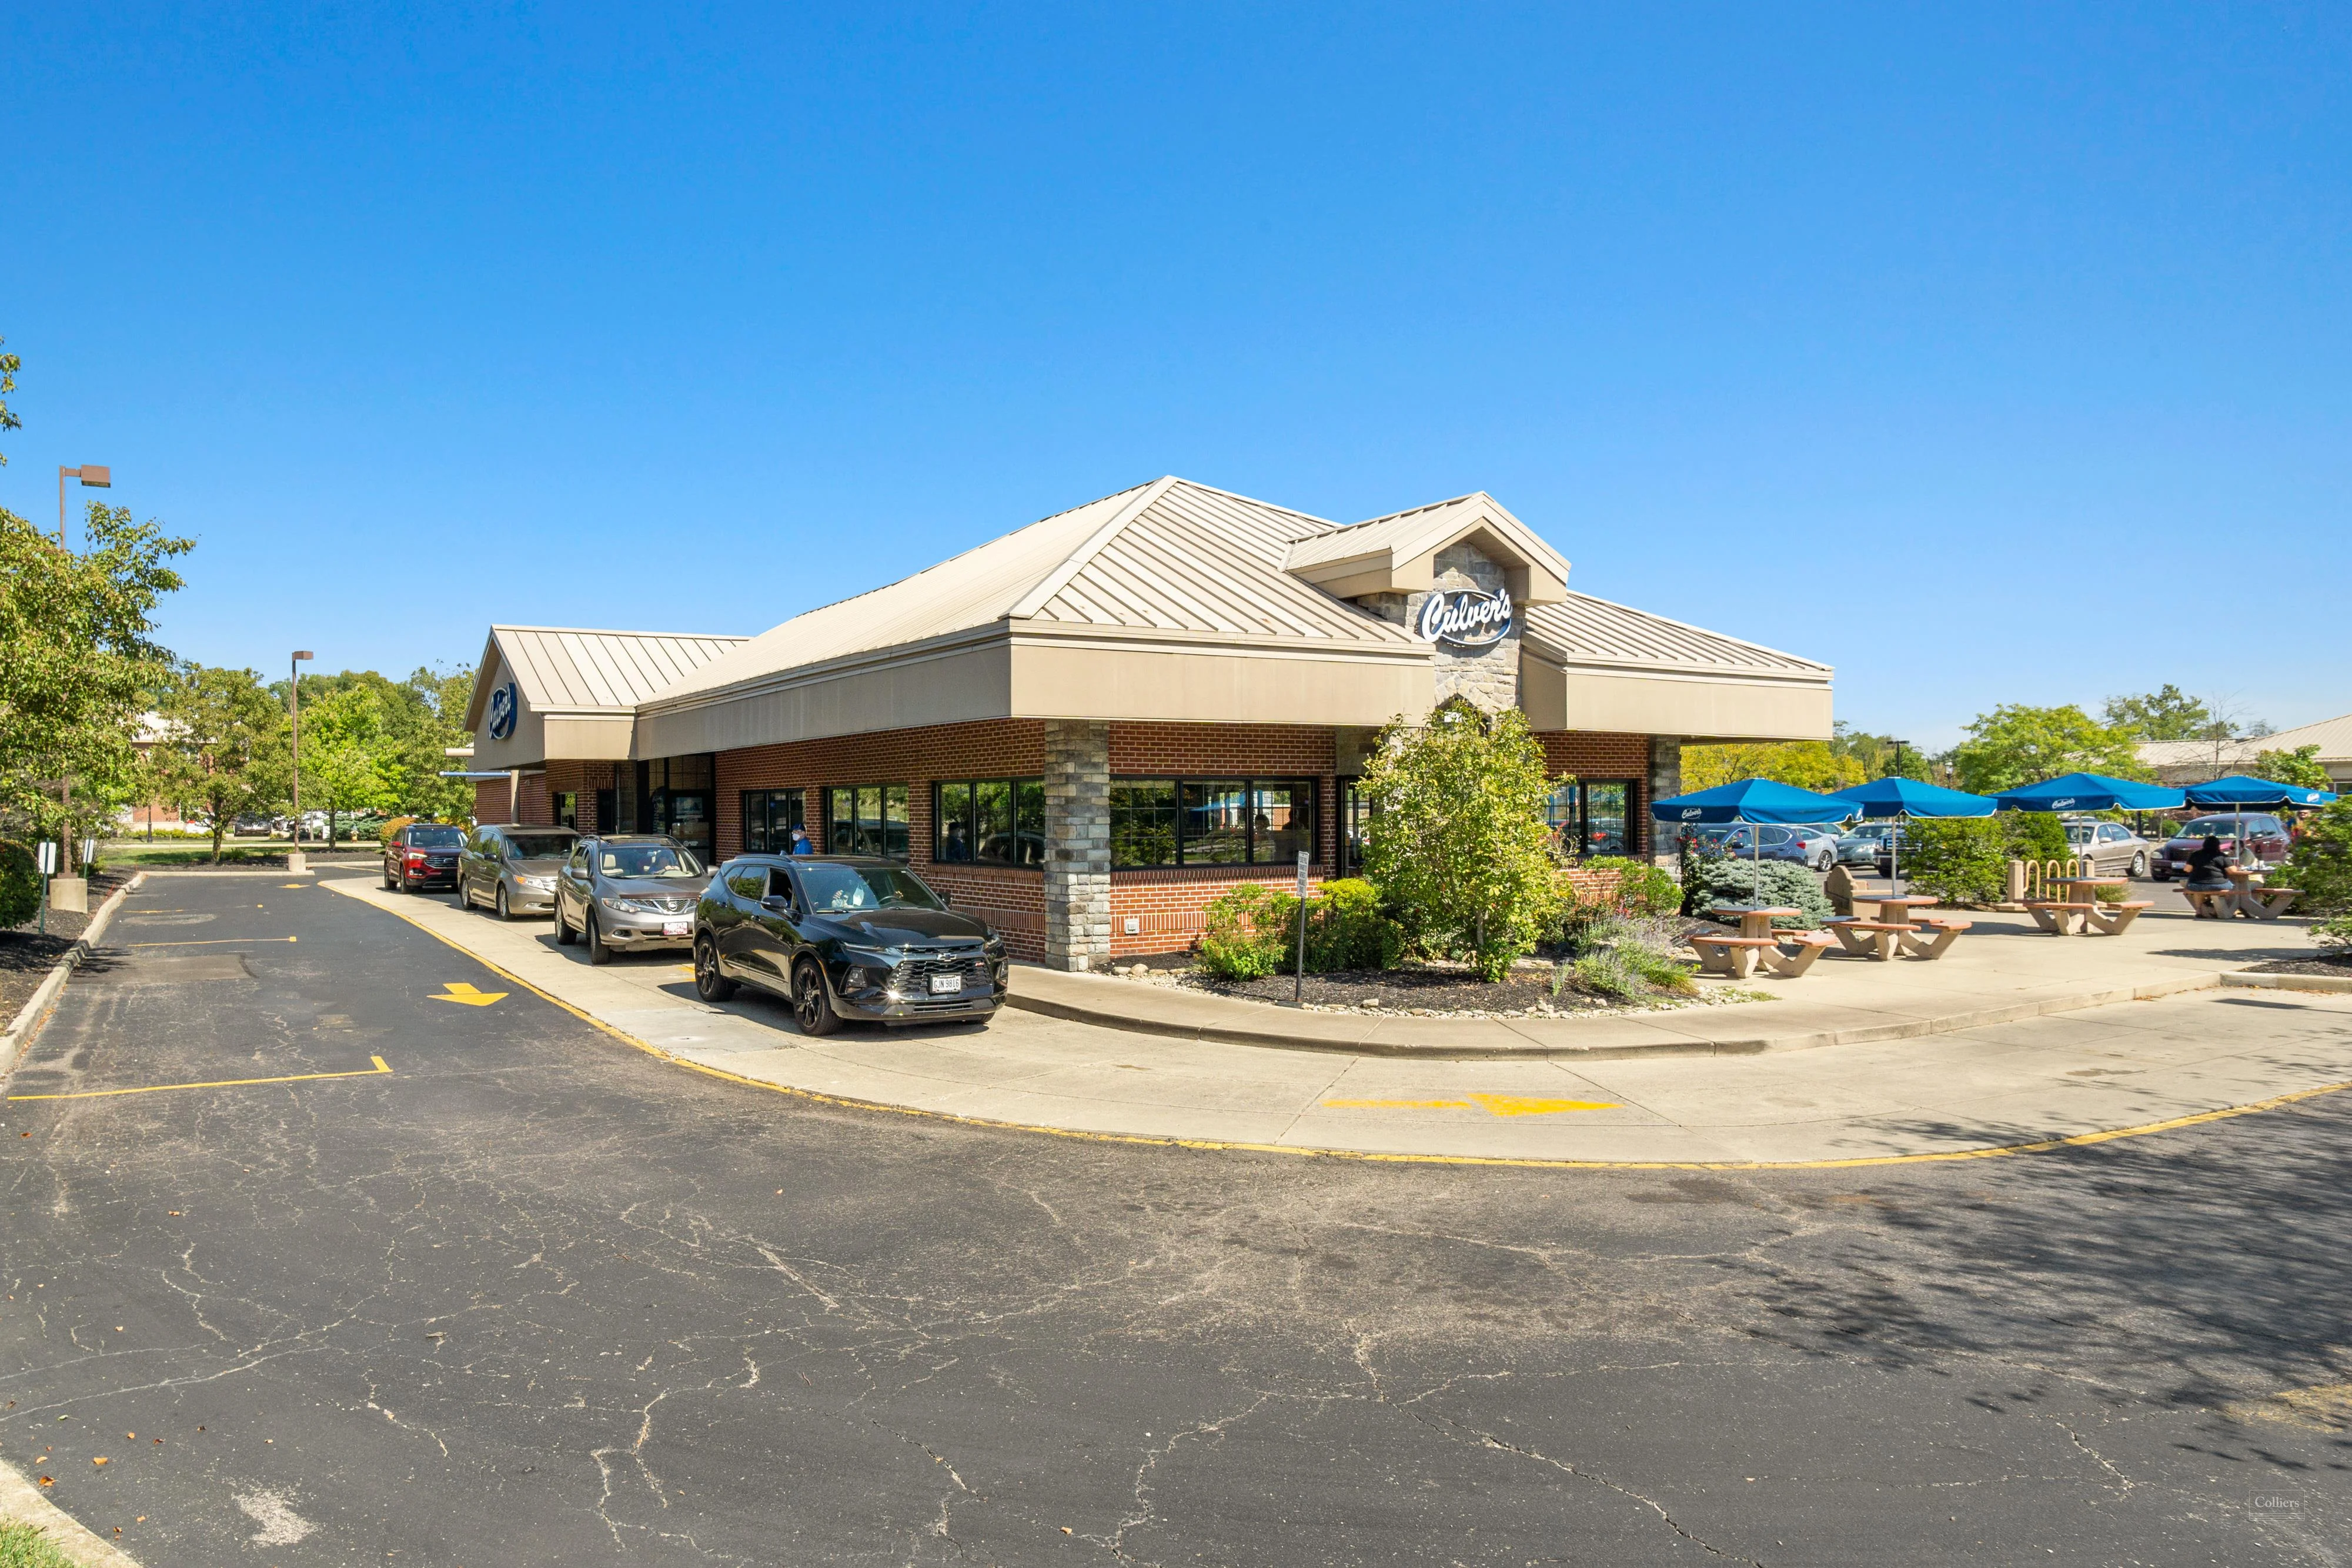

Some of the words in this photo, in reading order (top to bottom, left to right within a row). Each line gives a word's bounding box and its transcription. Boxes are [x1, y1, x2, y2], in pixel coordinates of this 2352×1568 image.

[1421, 588, 1512, 643] Culver's
[934, 979, 944, 988] GJN
[946, 979, 959, 988] 9816
